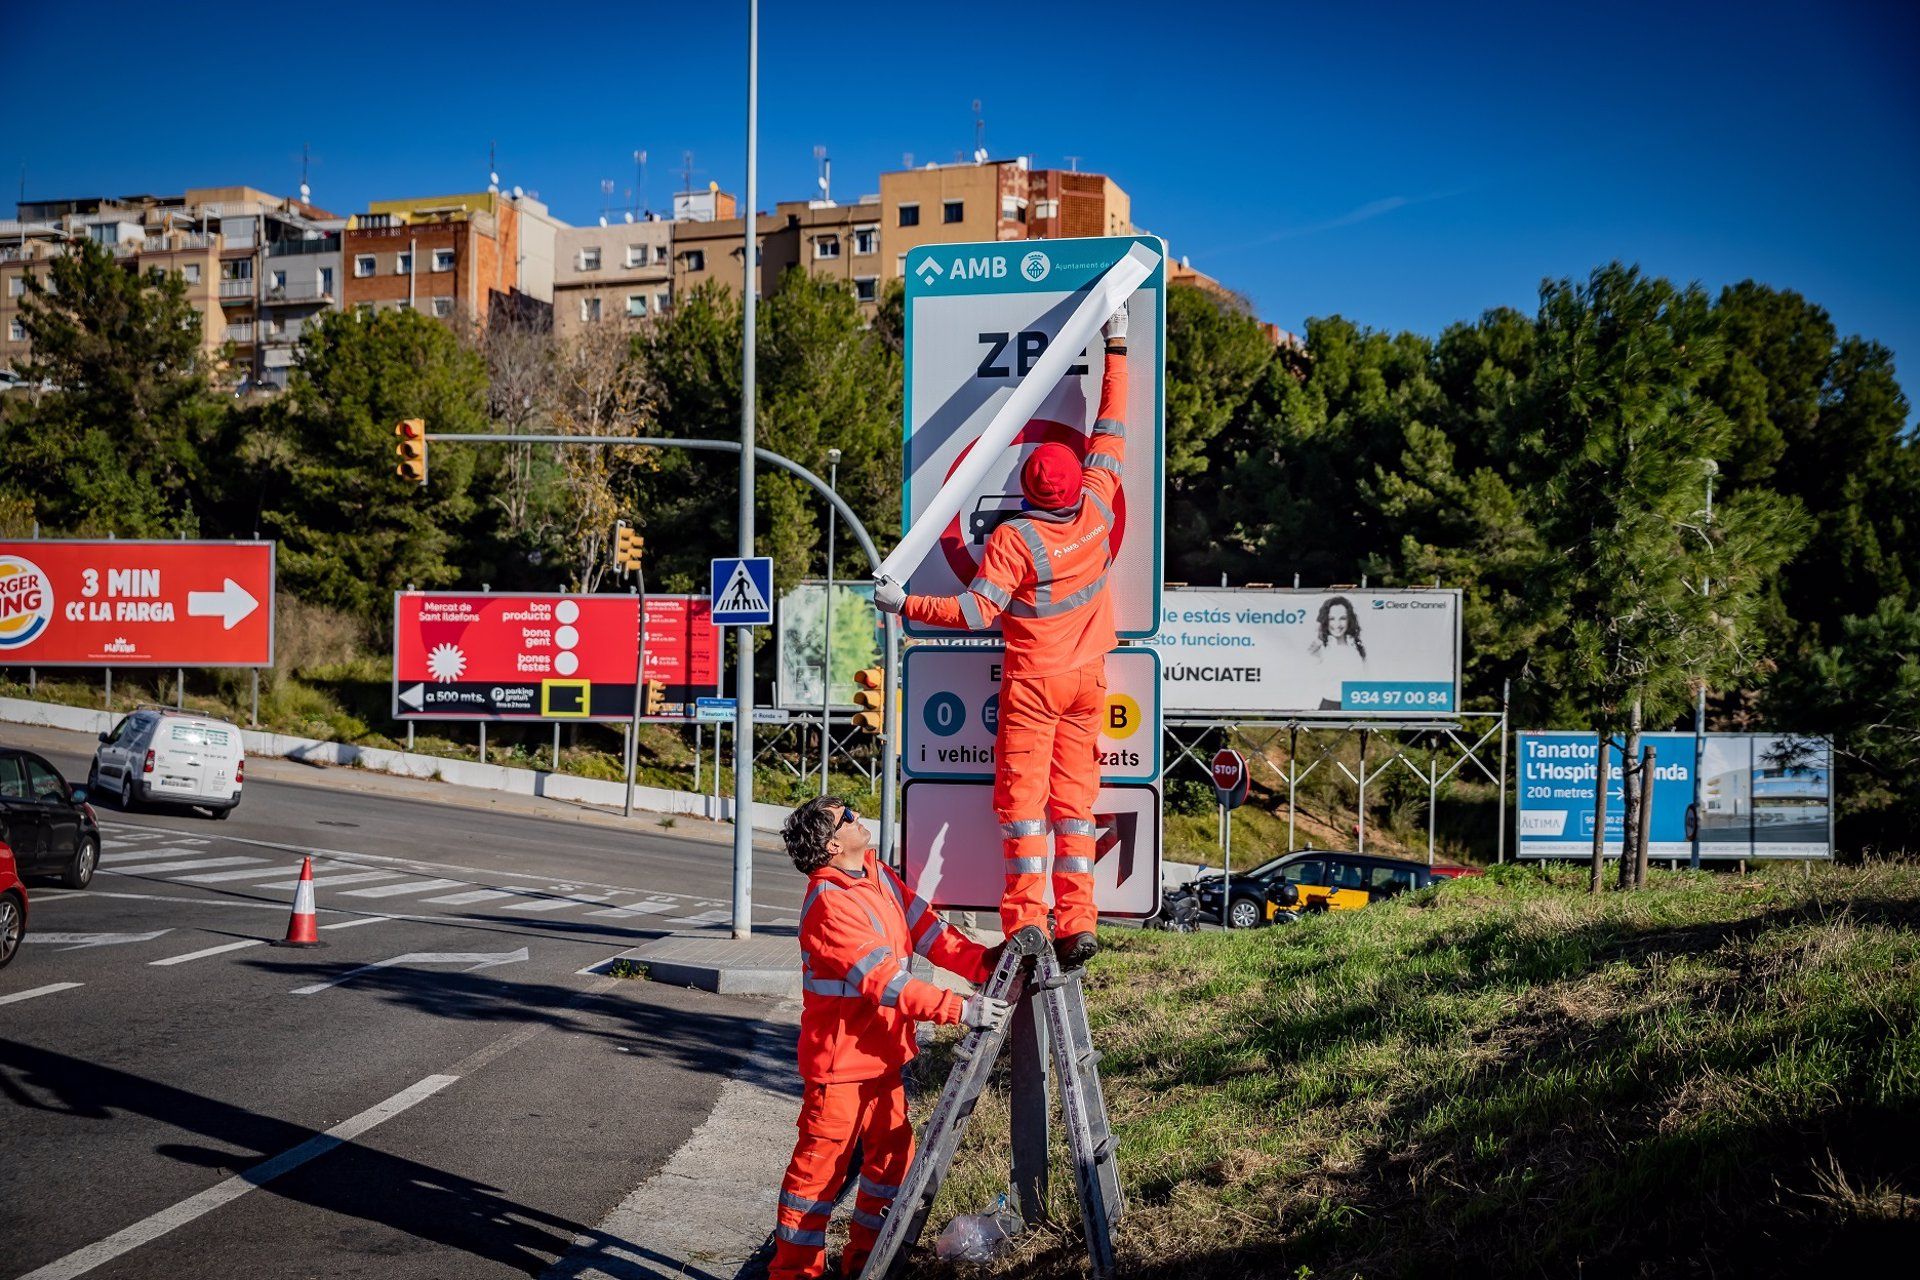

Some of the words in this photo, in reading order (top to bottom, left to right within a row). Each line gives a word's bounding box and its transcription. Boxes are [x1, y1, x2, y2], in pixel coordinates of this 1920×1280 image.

[949, 256, 1008, 280] AMB
[1055, 262, 1098, 271] Ajuntament
[1062, 542, 1080, 555] AMB
[1080, 523, 1106, 544] Rondes
[81, 568, 100, 598] 3
[107, 568, 161, 598] MIN
[0, 590, 42, 617] NG
[424, 601, 458, 611] Mercat
[459, 602, 472, 611] de
[530, 601, 551, 612] bon
[1385, 599, 1409, 609] Clear
[1410, 600, 1447, 609] Channel
[65, 601, 86, 622] CC
[89, 602, 112, 622] LA
[116, 602, 175, 622] FARGA
[419, 612, 441, 622] Sant
[442, 612, 480, 622] Ildefons
[502, 610, 552, 622] producte
[1183, 607, 1231, 623] estás
[1235, 608, 1306, 625] viendo?
[522, 627, 551, 637] bona
[525, 637, 551, 648] gent
[1181, 632, 1256, 647] funciona.
[517, 653, 551, 663] bones
[517, 662, 551, 672] festes
[425, 692, 435, 702] a
[436, 691, 459, 702] 500
[505, 687, 534, 697] parking
[505, 694, 529, 702] gratuit
[1350, 690, 1379, 704] 934
[1382, 691, 1402, 704] 97
[1404, 691, 1424, 704] 00
[1427, 691, 1448, 704] 84
[1110, 704, 1128, 729] B
[921, 744, 926, 762] i
[1525, 741, 1600, 758] Tanator
[1214, 764, 1238, 776] STOP
[1526, 786, 1552, 799] 200
[1553, 786, 1595, 799] metres
